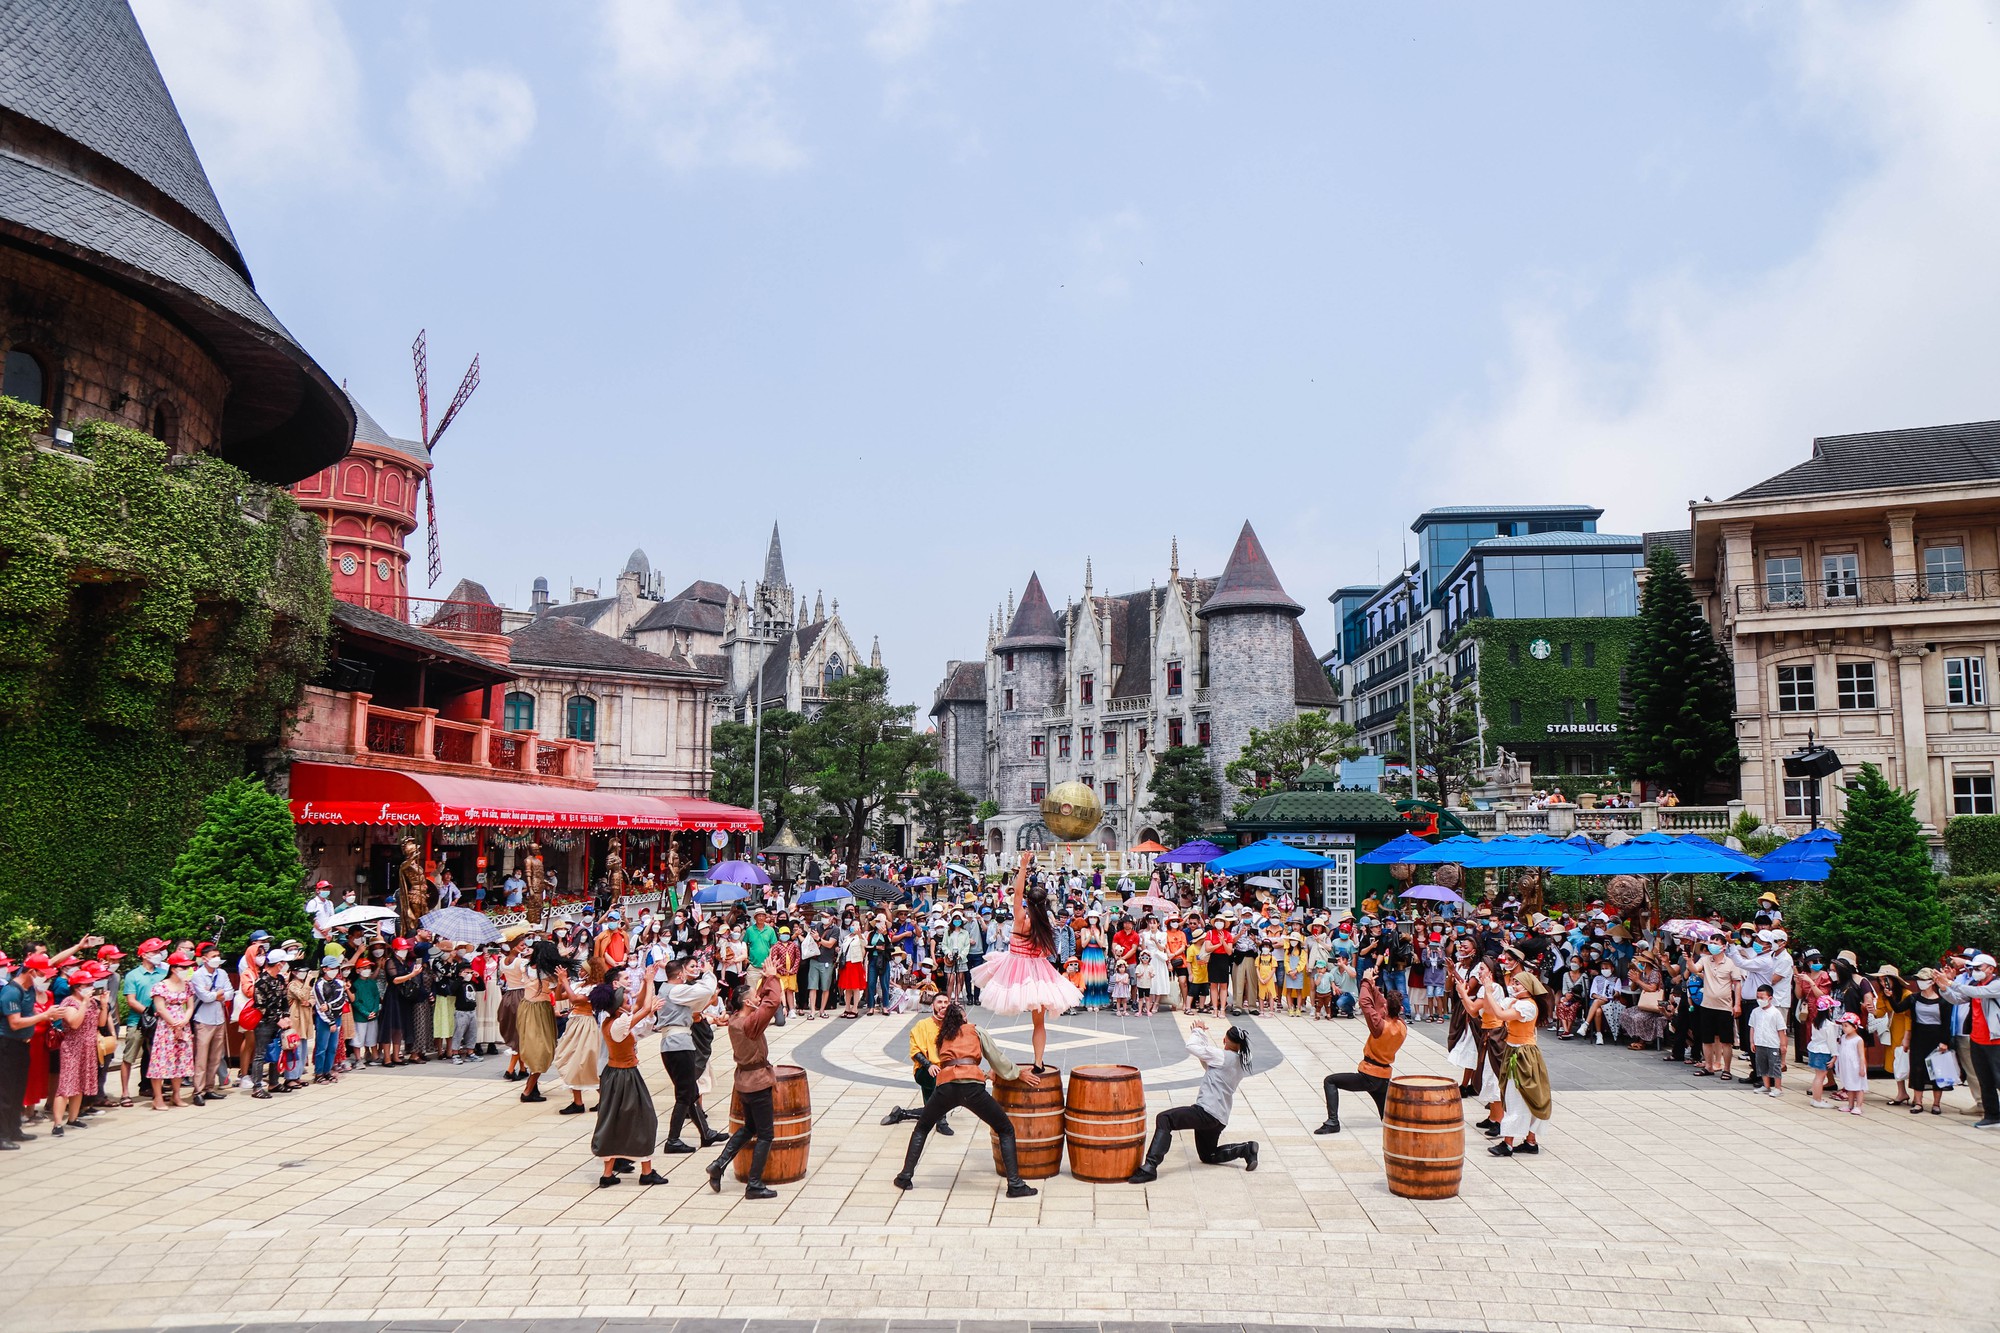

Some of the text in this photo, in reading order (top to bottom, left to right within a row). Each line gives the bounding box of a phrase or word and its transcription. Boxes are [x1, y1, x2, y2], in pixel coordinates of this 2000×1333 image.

[1546, 723, 1618, 733] STARBUCKS
[308, 812, 343, 820] FENCHA
[386, 812, 421, 821] FENCHA
